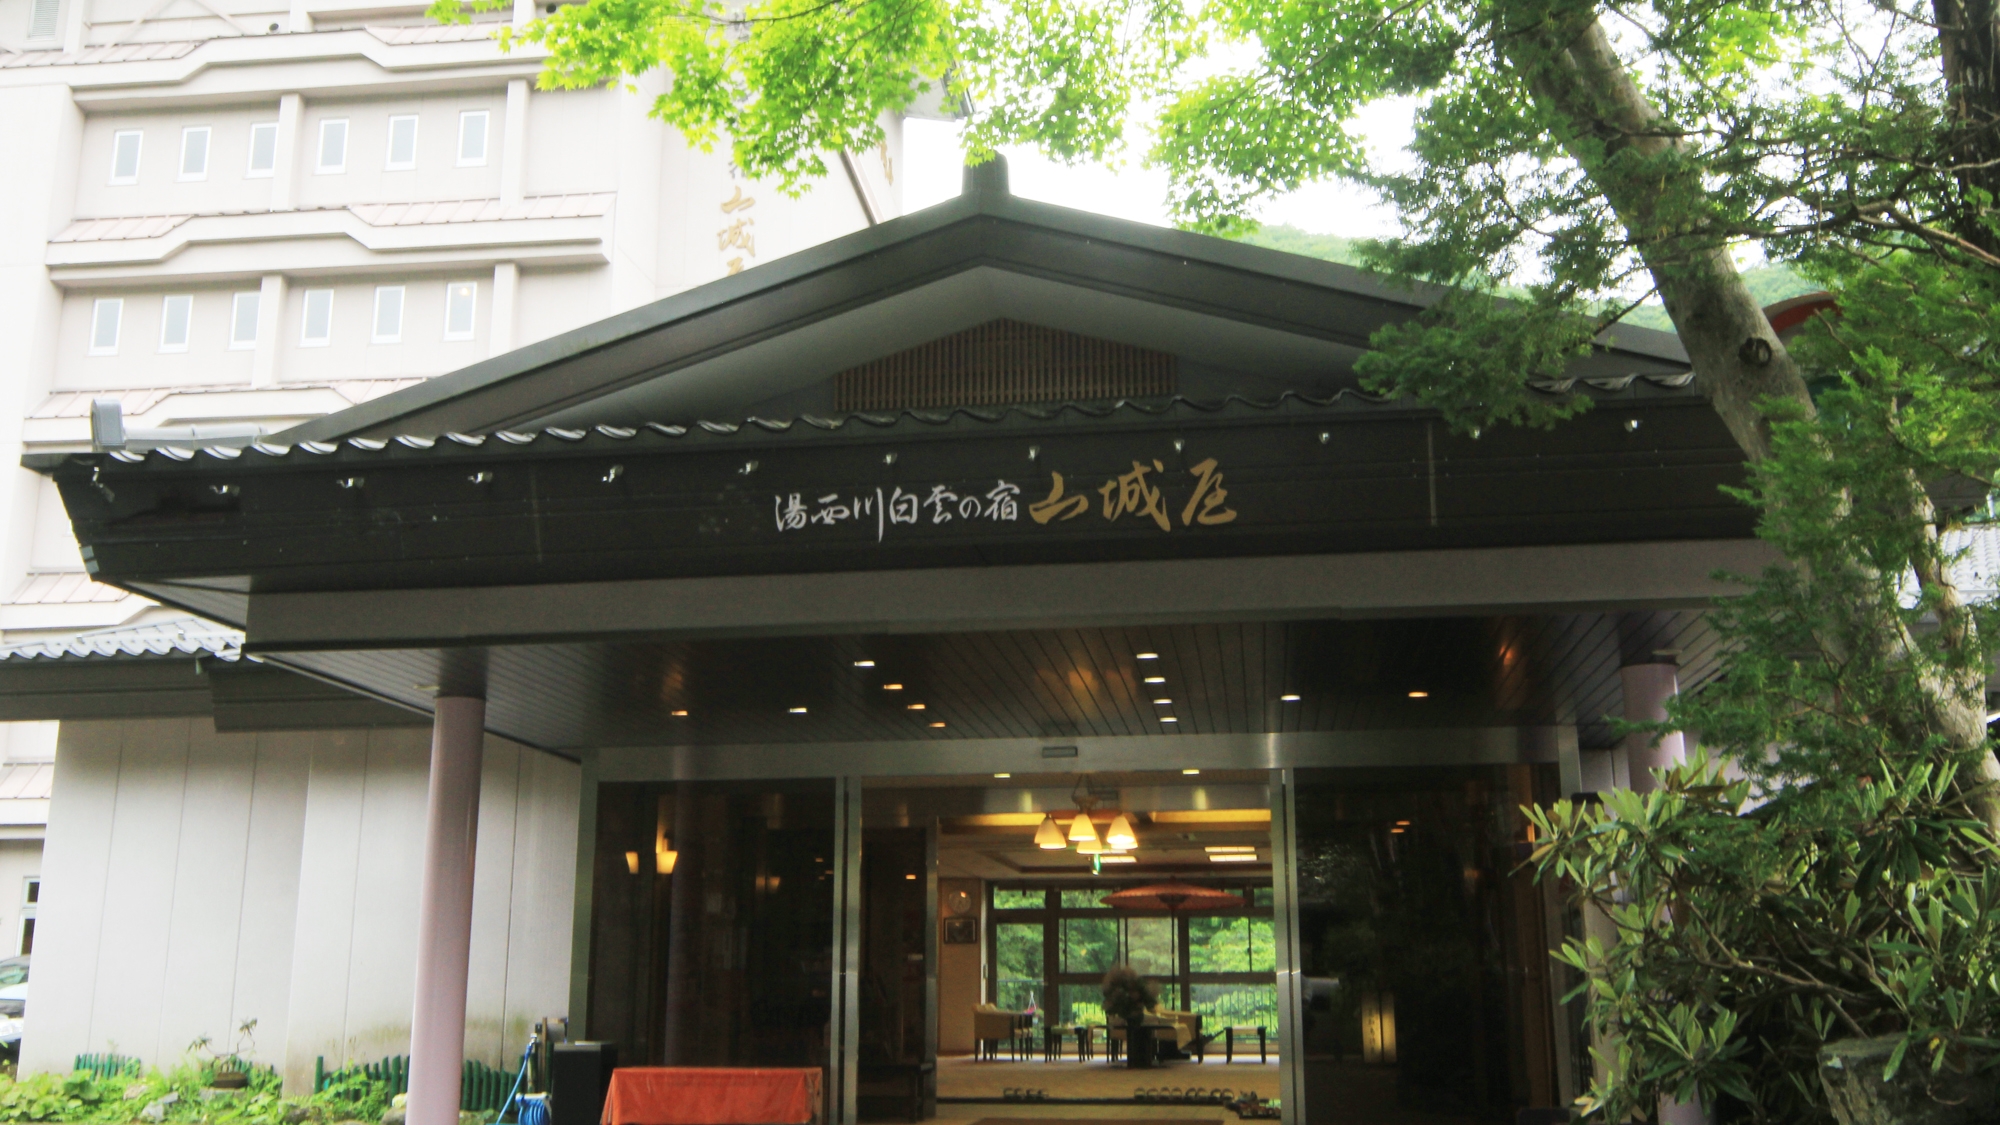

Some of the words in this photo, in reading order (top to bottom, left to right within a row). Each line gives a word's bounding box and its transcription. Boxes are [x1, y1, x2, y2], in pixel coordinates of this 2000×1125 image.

[775, 480, 1020, 543] 湯西川白雲の宿
[1029, 457, 1238, 532] 山城屋
